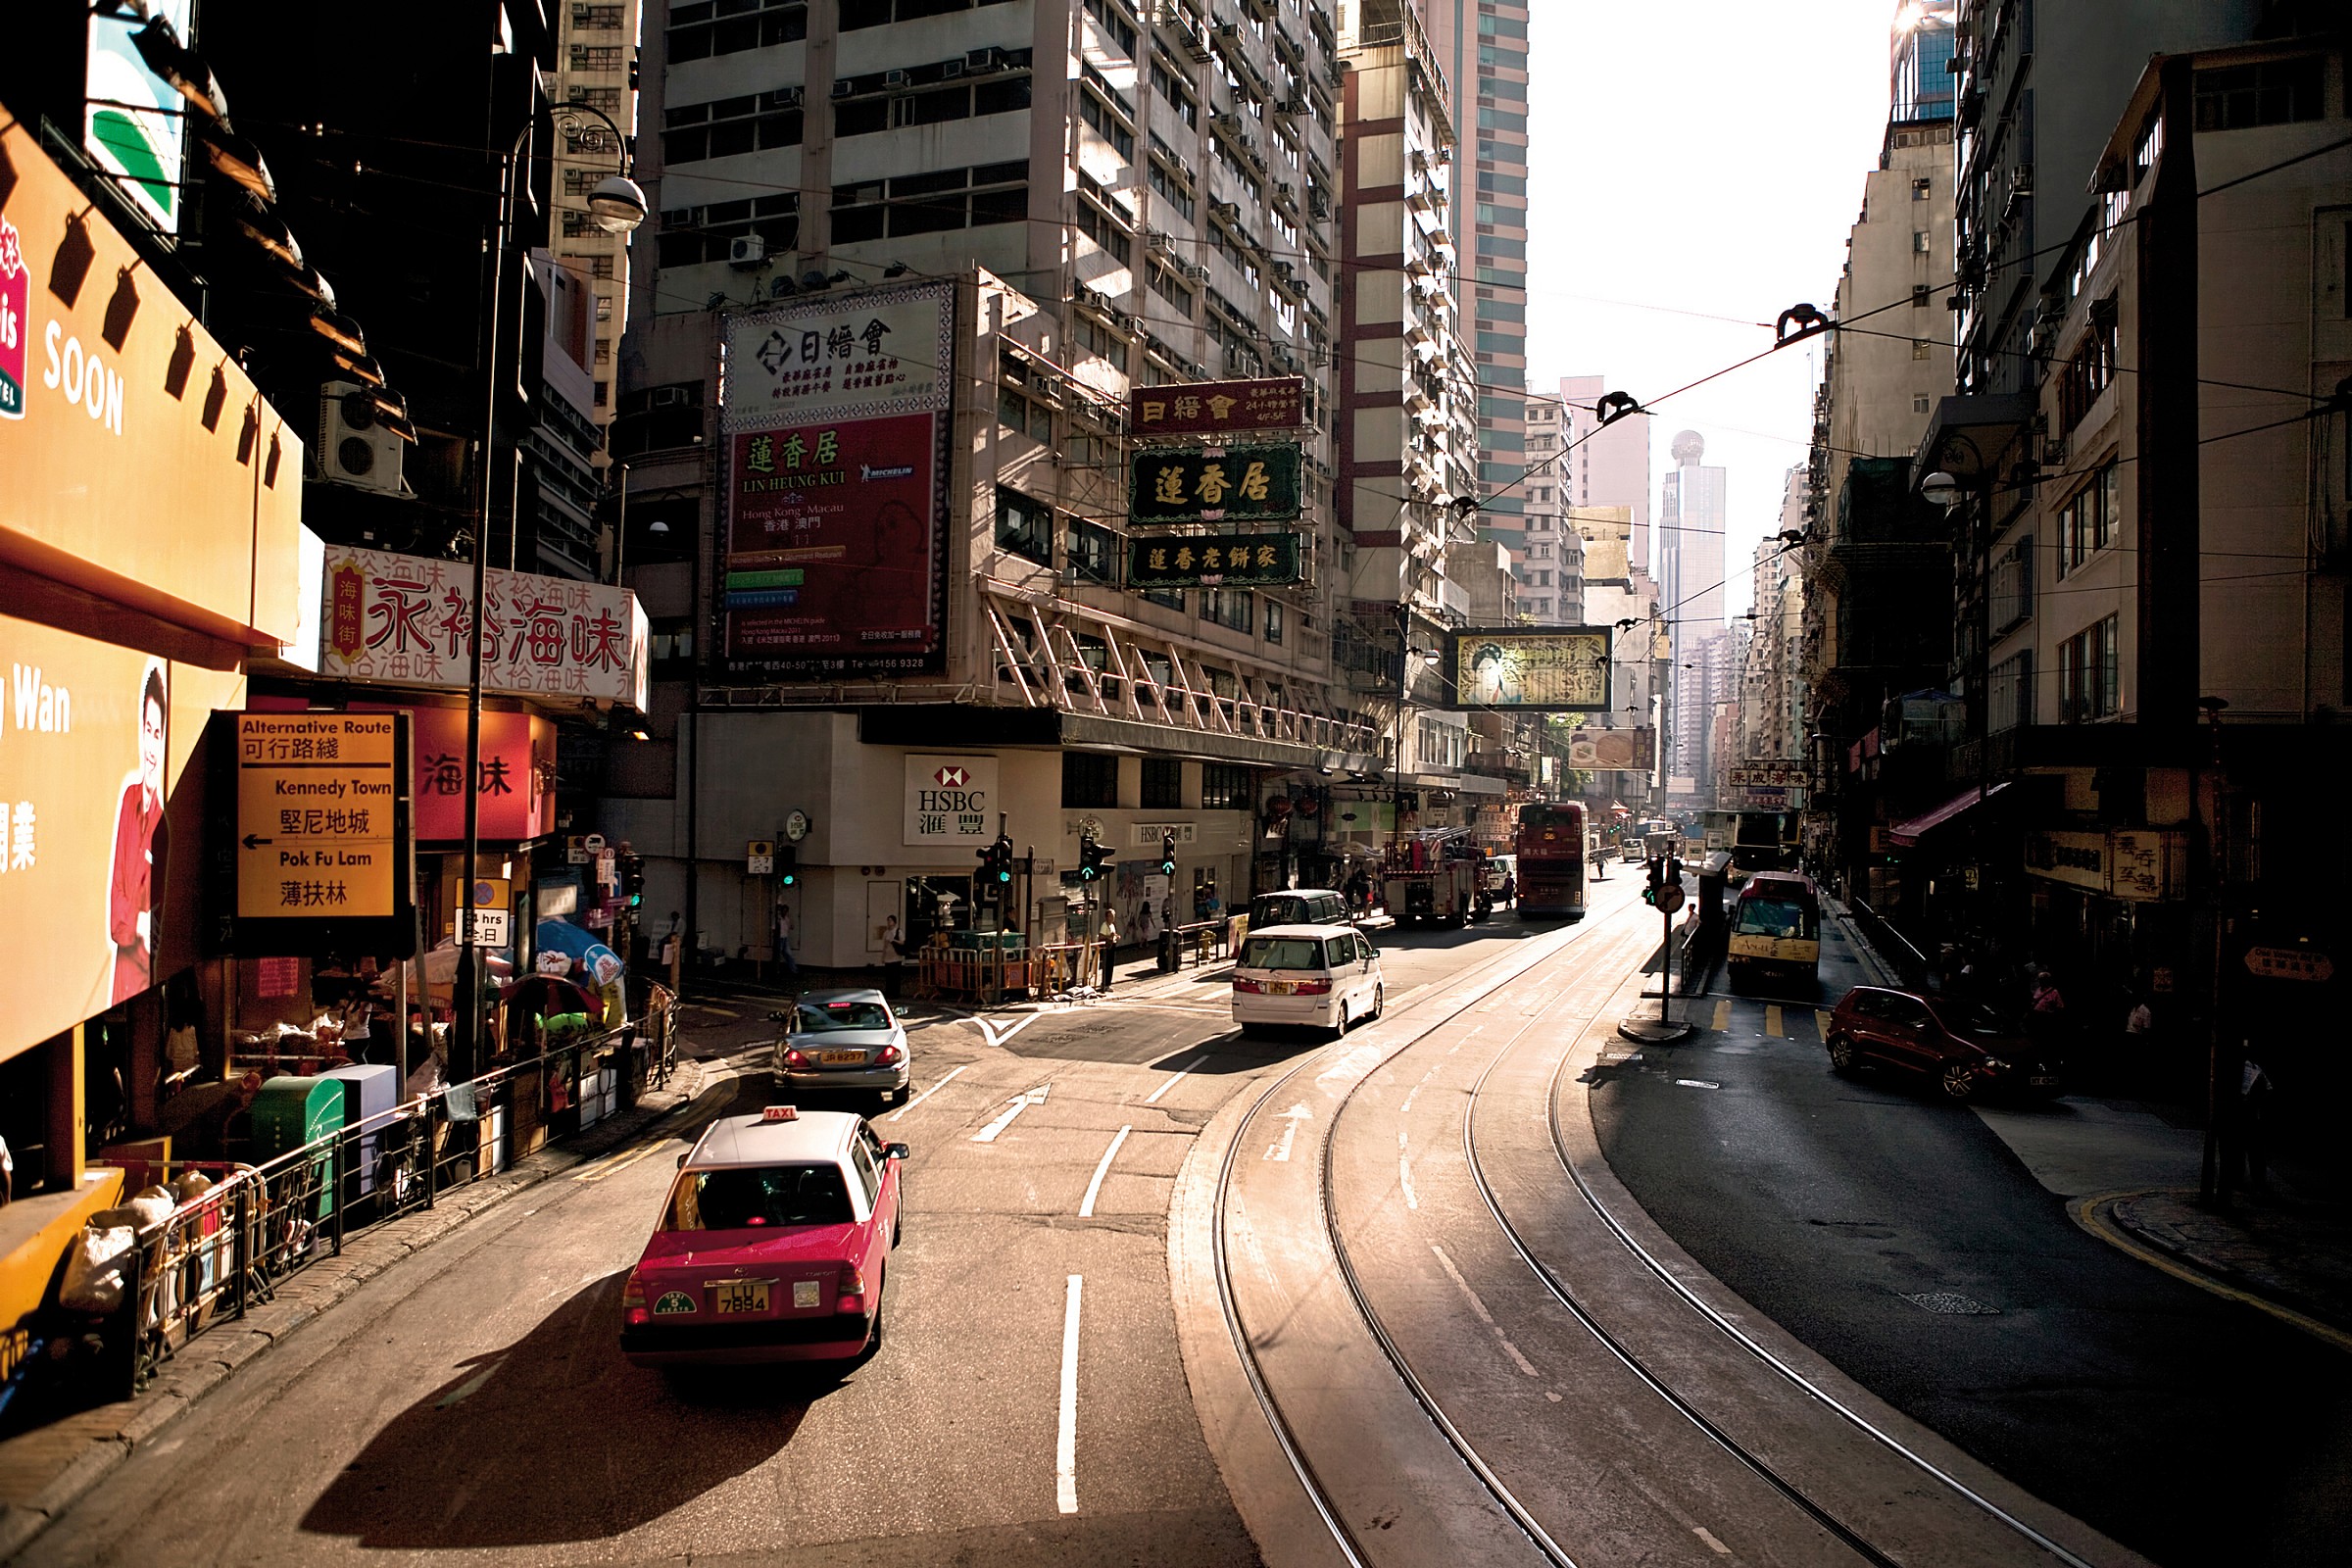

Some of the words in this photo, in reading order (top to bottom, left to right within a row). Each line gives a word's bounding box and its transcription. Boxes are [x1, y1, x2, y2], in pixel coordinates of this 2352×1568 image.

[0, 294, 18, 350] is
[44, 319, 124, 436] SOON
[747, 430, 840, 473] 蓮香居
[743, 479, 765, 493] LIN
[769, 474, 816, 490] HEUNG
[820, 470, 846, 485] KUI
[870, 466, 913, 477] MICHELIN
[1155, 462, 1271, 505] 蓮香居
[743, 510, 771, 520] Hong
[774, 508, 802, 518] Kong
[807, 504, 844, 514] Macau
[763, 519, 790, 532] 香港
[795, 516, 821, 530] 澳門
[1149, 545, 1278, 570] 蓮香老餅家
[338, 580, 357, 645] 海味街
[365, 577, 628, 673] 永裕海味
[900, 658, 924, 667] 9328
[13, 662, 71, 733] Wan
[243, 720, 338, 734] Alternative
[344, 720, 392, 734] Route
[422, 753, 514, 797] 海味
[275, 779, 346, 799] Kennedy
[351, 779, 392, 795] Town
[918, 790, 985, 812] HSBC
[280, 808, 369, 834] 堅尼地城
[1141, 826, 1162, 843] HSBC
[280, 851, 310, 866] Pok
[316, 851, 333, 866] Fu
[338, 851, 372, 866] Lam
[280, 880, 348, 906] 薄扶林
[482, 913, 503, 924] hrs
[766, 1108, 793, 1118] TAXI
[671, 1298, 679, 1307] 5
[731, 1286, 755, 1298] LU
[720, 1298, 766, 1313] 7894
